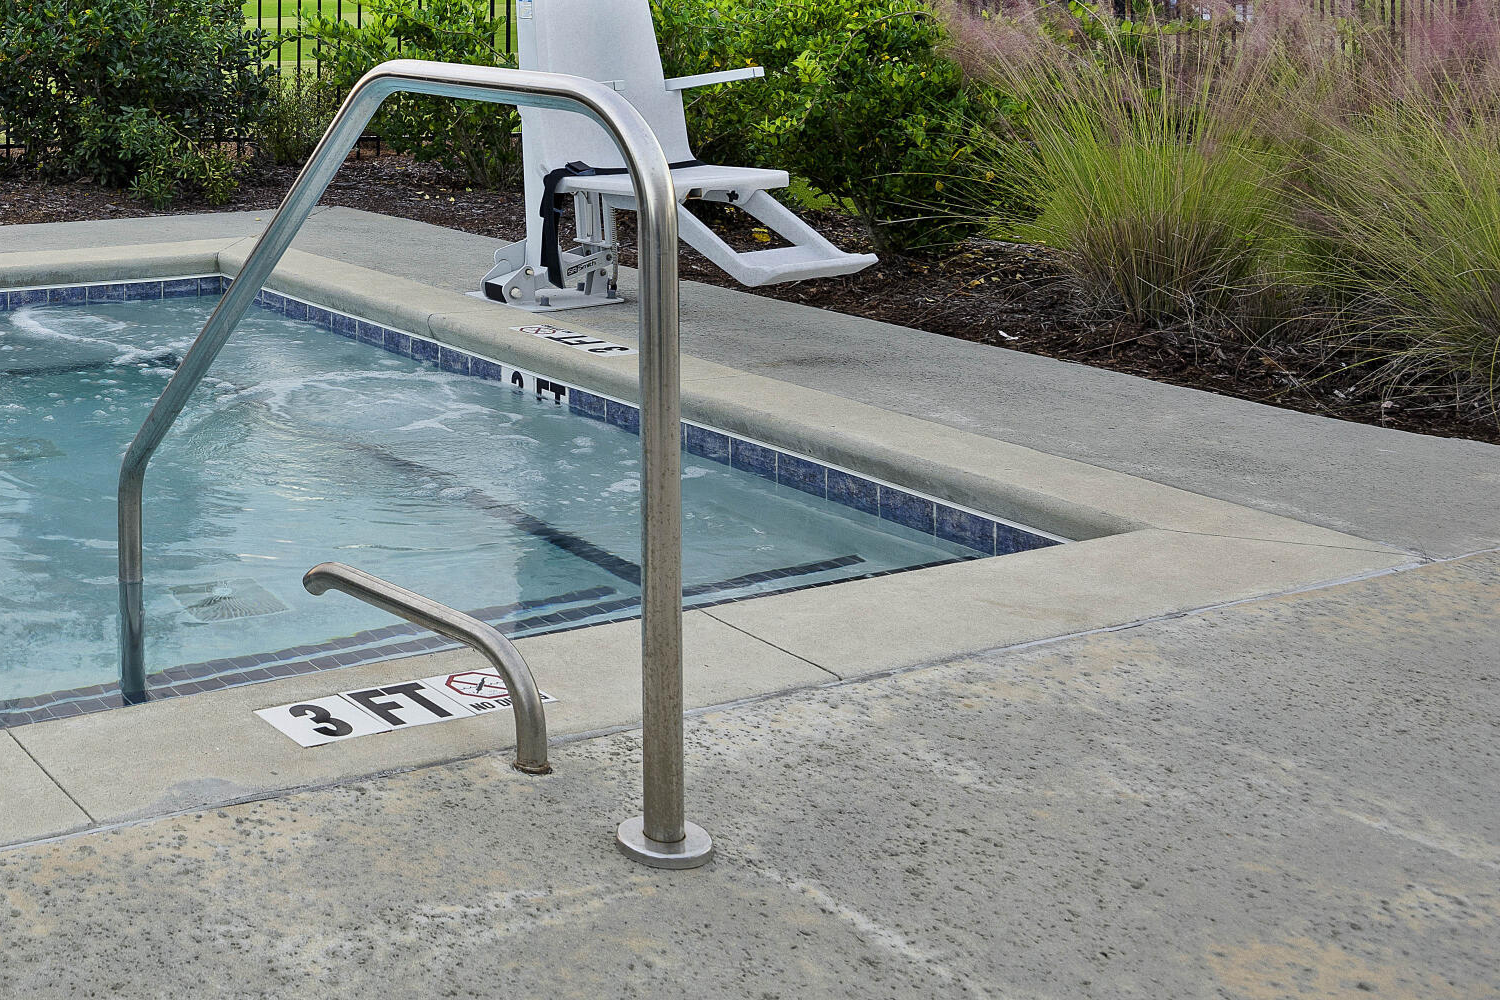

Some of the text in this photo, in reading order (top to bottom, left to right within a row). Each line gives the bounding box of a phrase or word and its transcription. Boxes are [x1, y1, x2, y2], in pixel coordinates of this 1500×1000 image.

[545, 335, 606, 346] FT
[288, 682, 453, 736] 3 FT
[469, 701, 496, 711] NO
